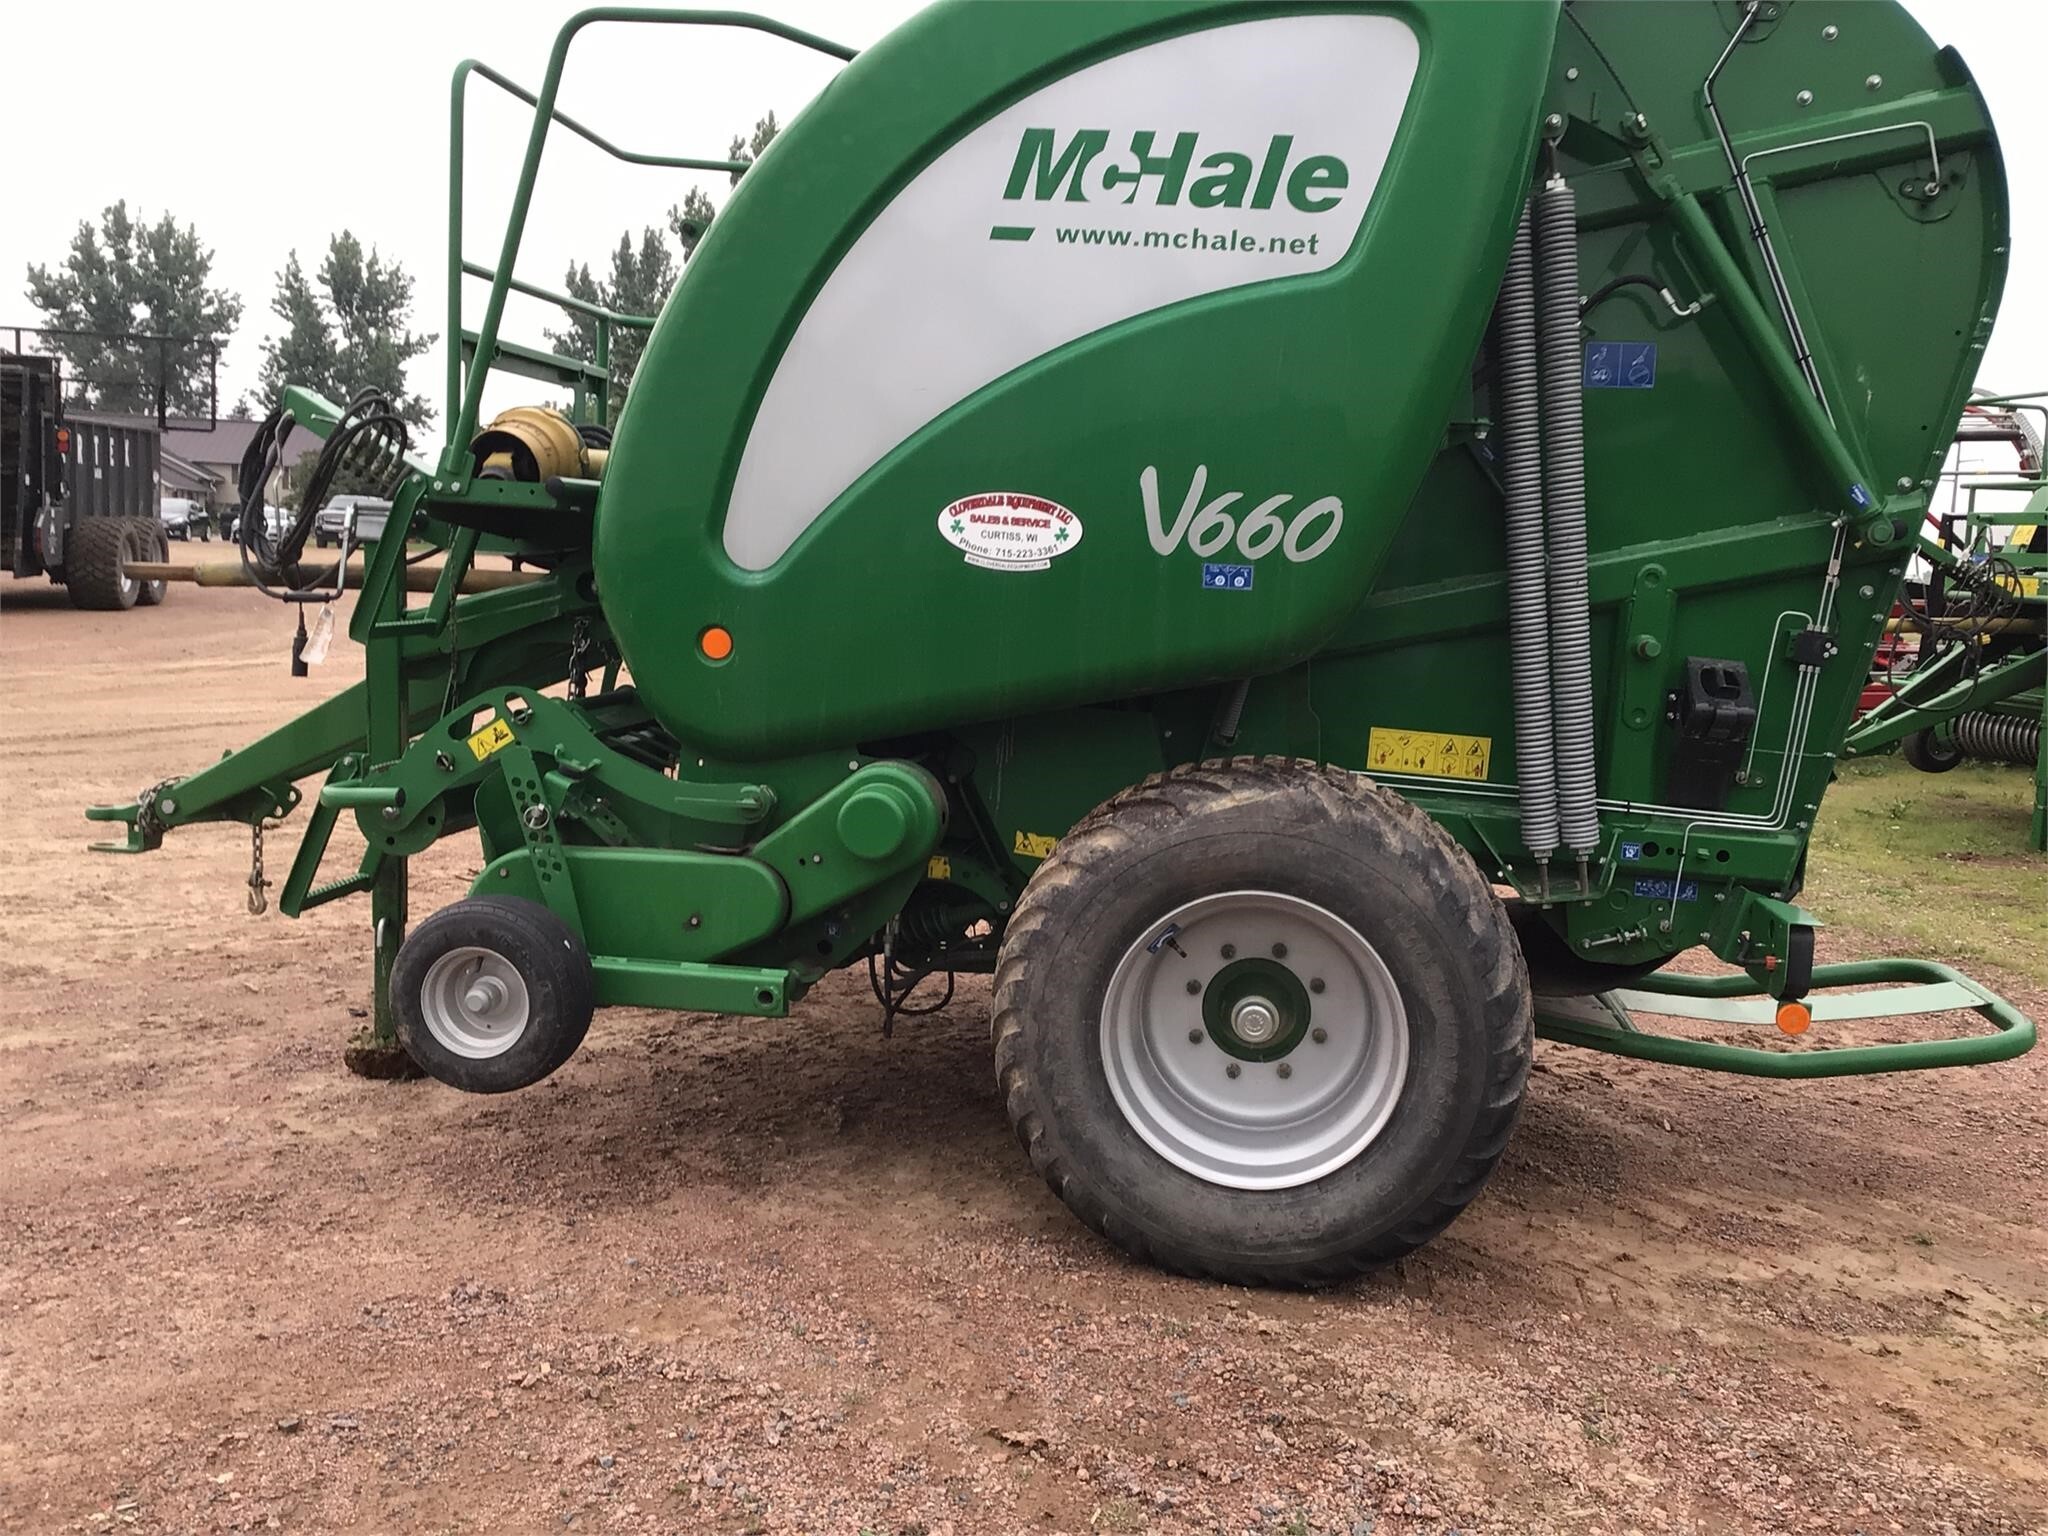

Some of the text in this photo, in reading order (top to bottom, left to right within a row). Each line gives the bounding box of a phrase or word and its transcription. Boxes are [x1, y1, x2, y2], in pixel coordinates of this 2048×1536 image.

[1003, 128, 1349, 213] McHale
[1056, 227, 1319, 255] www.mchale.net
[62, 433, 130, 467] RTEX
[970, 514, 1051, 528] SALES & SERVICE
[1006, 495, 1058, 516] EQUIPMENT
[1055, 508, 1073, 525] LLC
[1140, 464, 1344, 562] V660
[958, 537, 992, 556] Phone:
[980, 529, 1038, 543] CURTISS, WI
